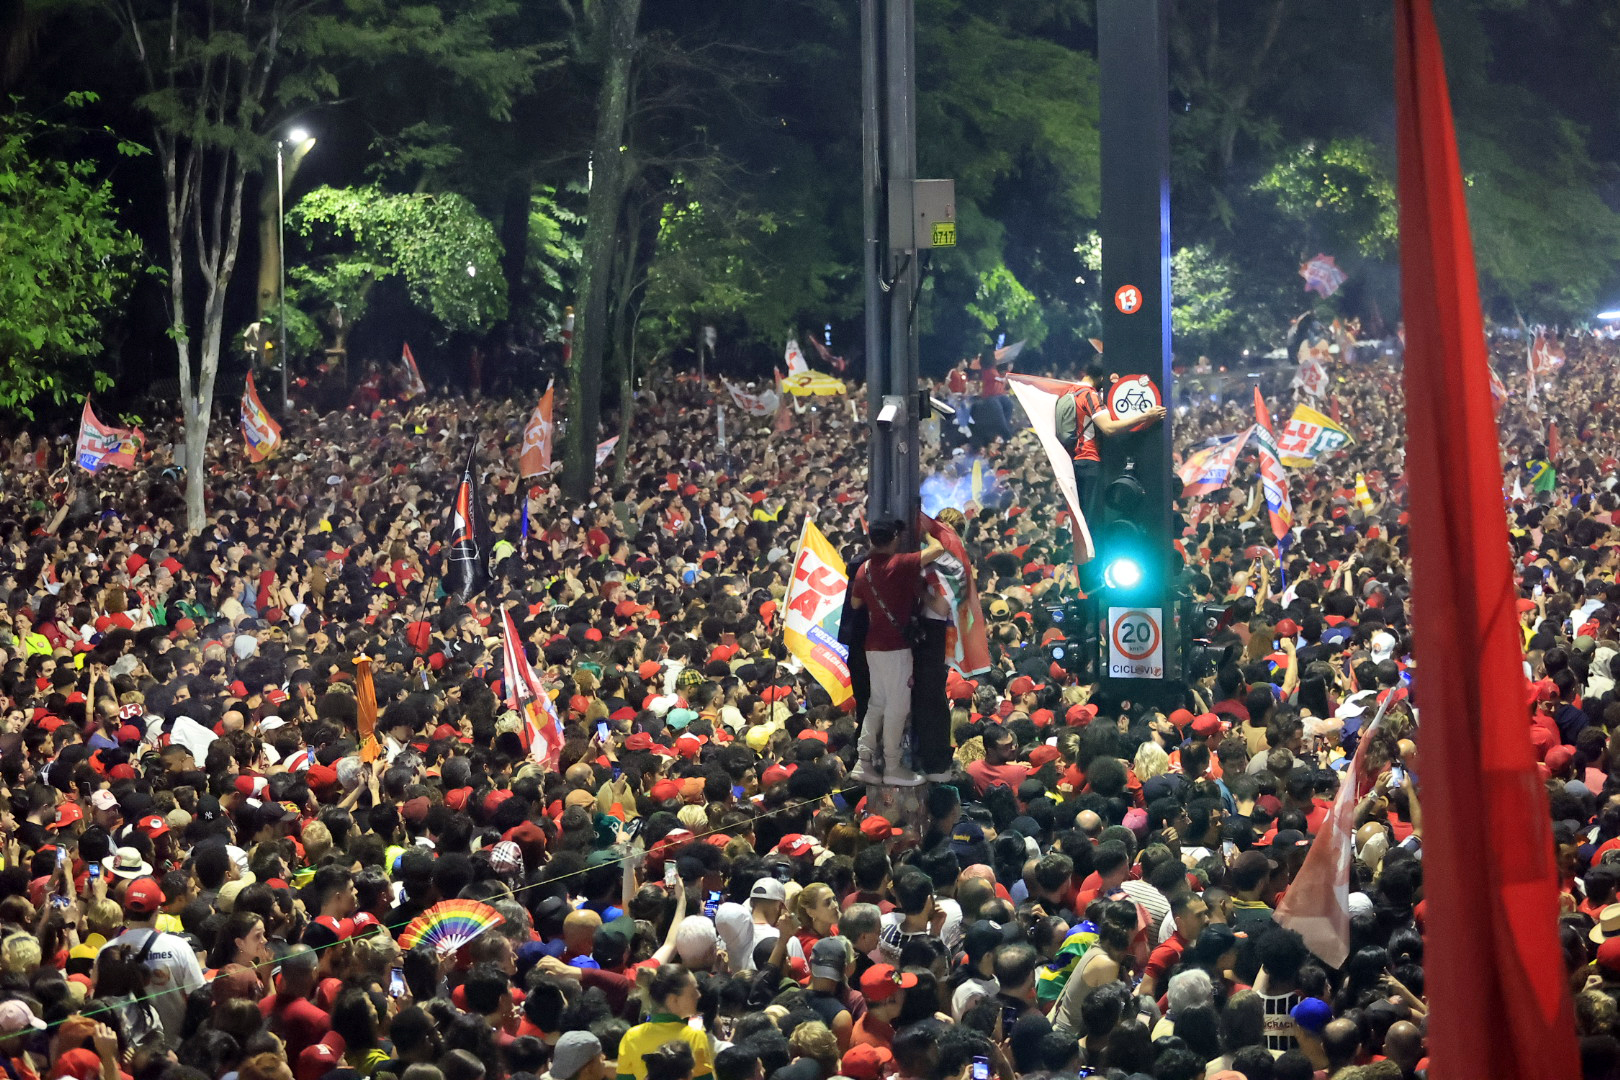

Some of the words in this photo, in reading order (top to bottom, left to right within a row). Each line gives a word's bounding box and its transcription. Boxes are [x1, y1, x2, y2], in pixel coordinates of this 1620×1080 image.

[933, 231, 954, 244] 0717
[1118, 289, 1137, 310] 13
[788, 588, 822, 621] A
[1121, 622, 1150, 643] 20
[811, 628, 849, 660] PRESIDENT
[1112, 664, 1160, 675] CICLVI
[119, 703, 143, 717] 13
